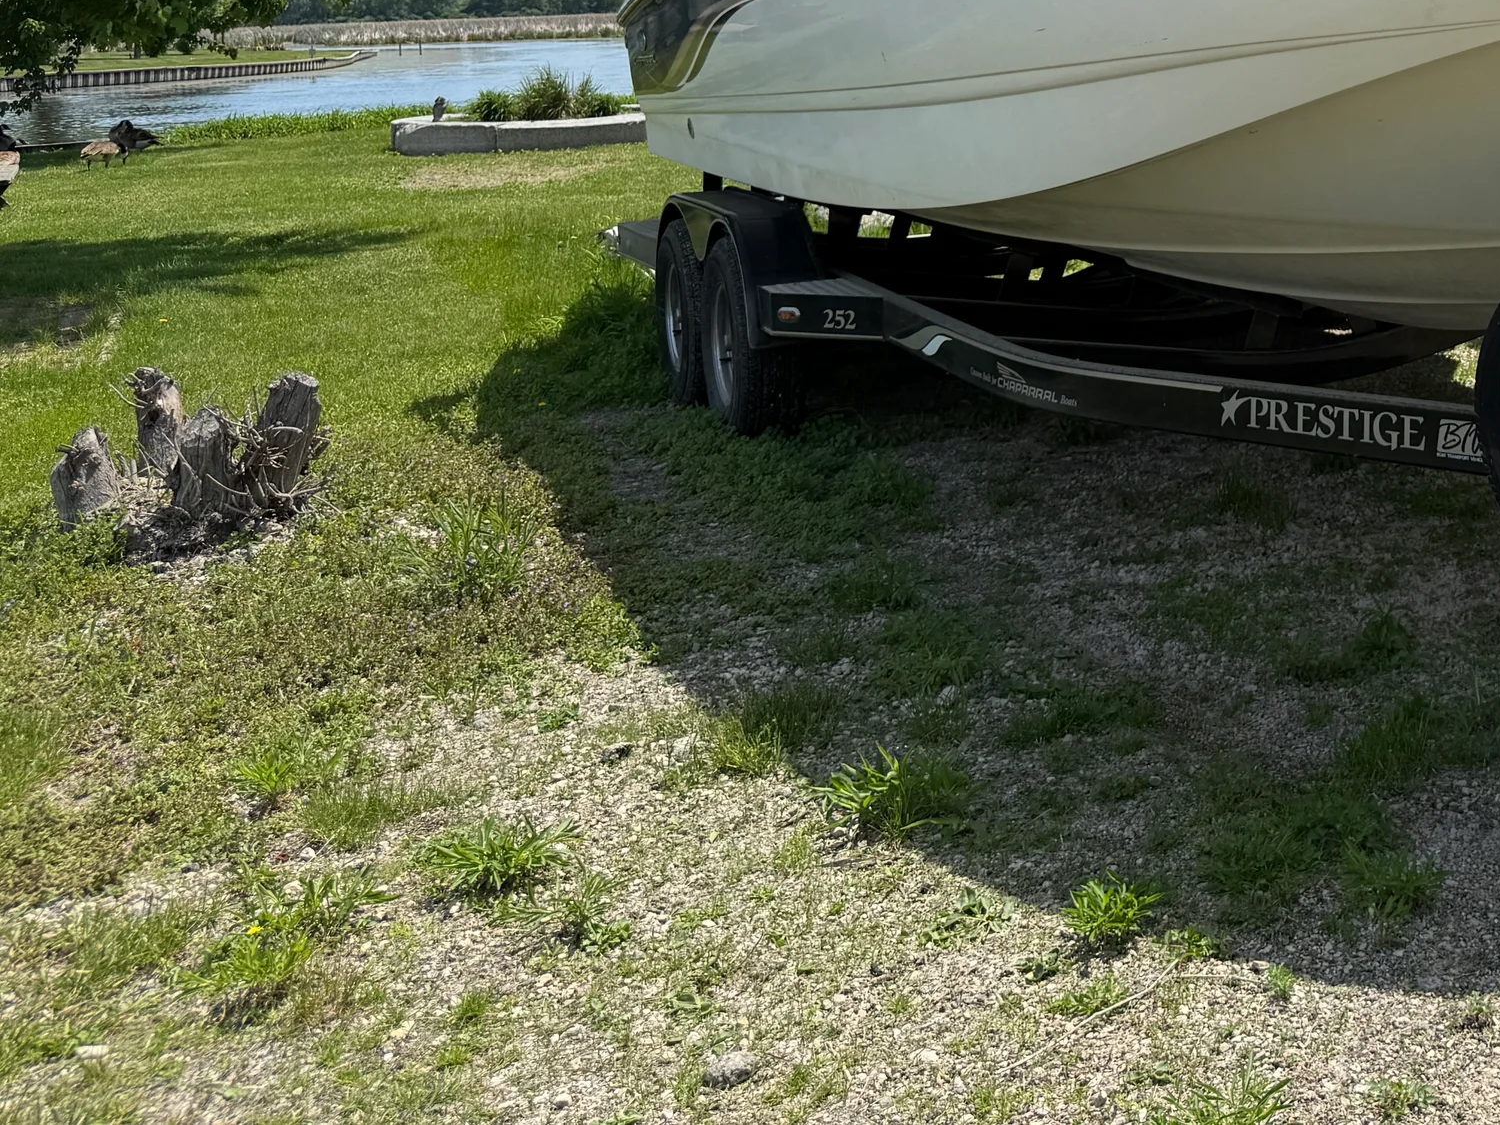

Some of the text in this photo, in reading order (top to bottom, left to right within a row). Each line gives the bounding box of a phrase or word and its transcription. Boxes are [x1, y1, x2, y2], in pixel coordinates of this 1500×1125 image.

[823, 308, 857, 330] 252
[997, 377, 1058, 403] CHAPARRAL
[1060, 394, 1078, 407] Boats
[1247, 396, 1426, 452] PRESTIGE
